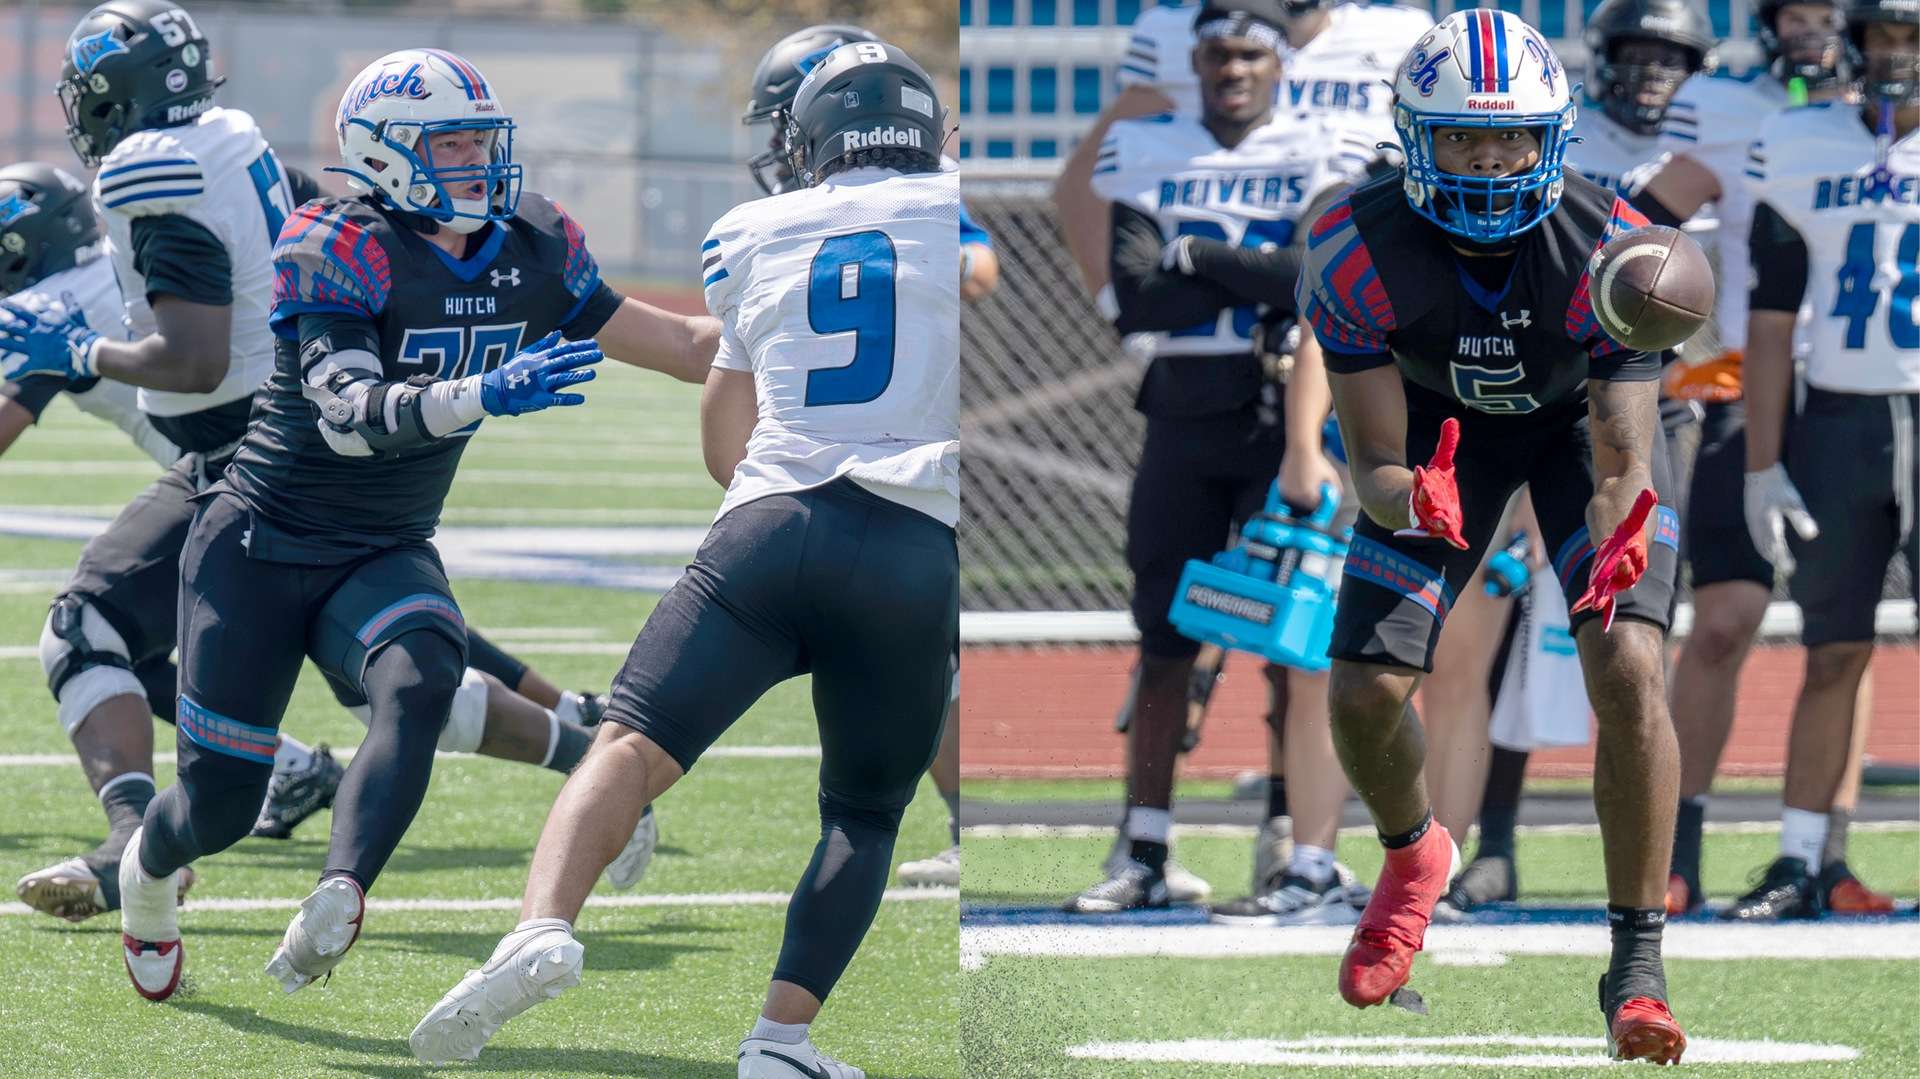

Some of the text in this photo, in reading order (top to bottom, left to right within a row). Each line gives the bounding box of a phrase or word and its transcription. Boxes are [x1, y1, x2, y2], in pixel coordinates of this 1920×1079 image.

[150, 9, 203, 47] 57
[856, 44, 888, 63] 9
[340, 63, 428, 125] Hutch
[474, 103, 496, 112] Hutch
[1273, 80, 1371, 111] IVERS
[1468, 99, 1514, 110] Riddell
[844, 126, 922, 150] Riddell
[1158, 176, 1306, 208] REIVERS
[445, 297, 496, 315] HUTCH
[804, 230, 897, 407] 9
[1458, 336, 1515, 357] HUTCH
[1449, 361, 1541, 414] 5
